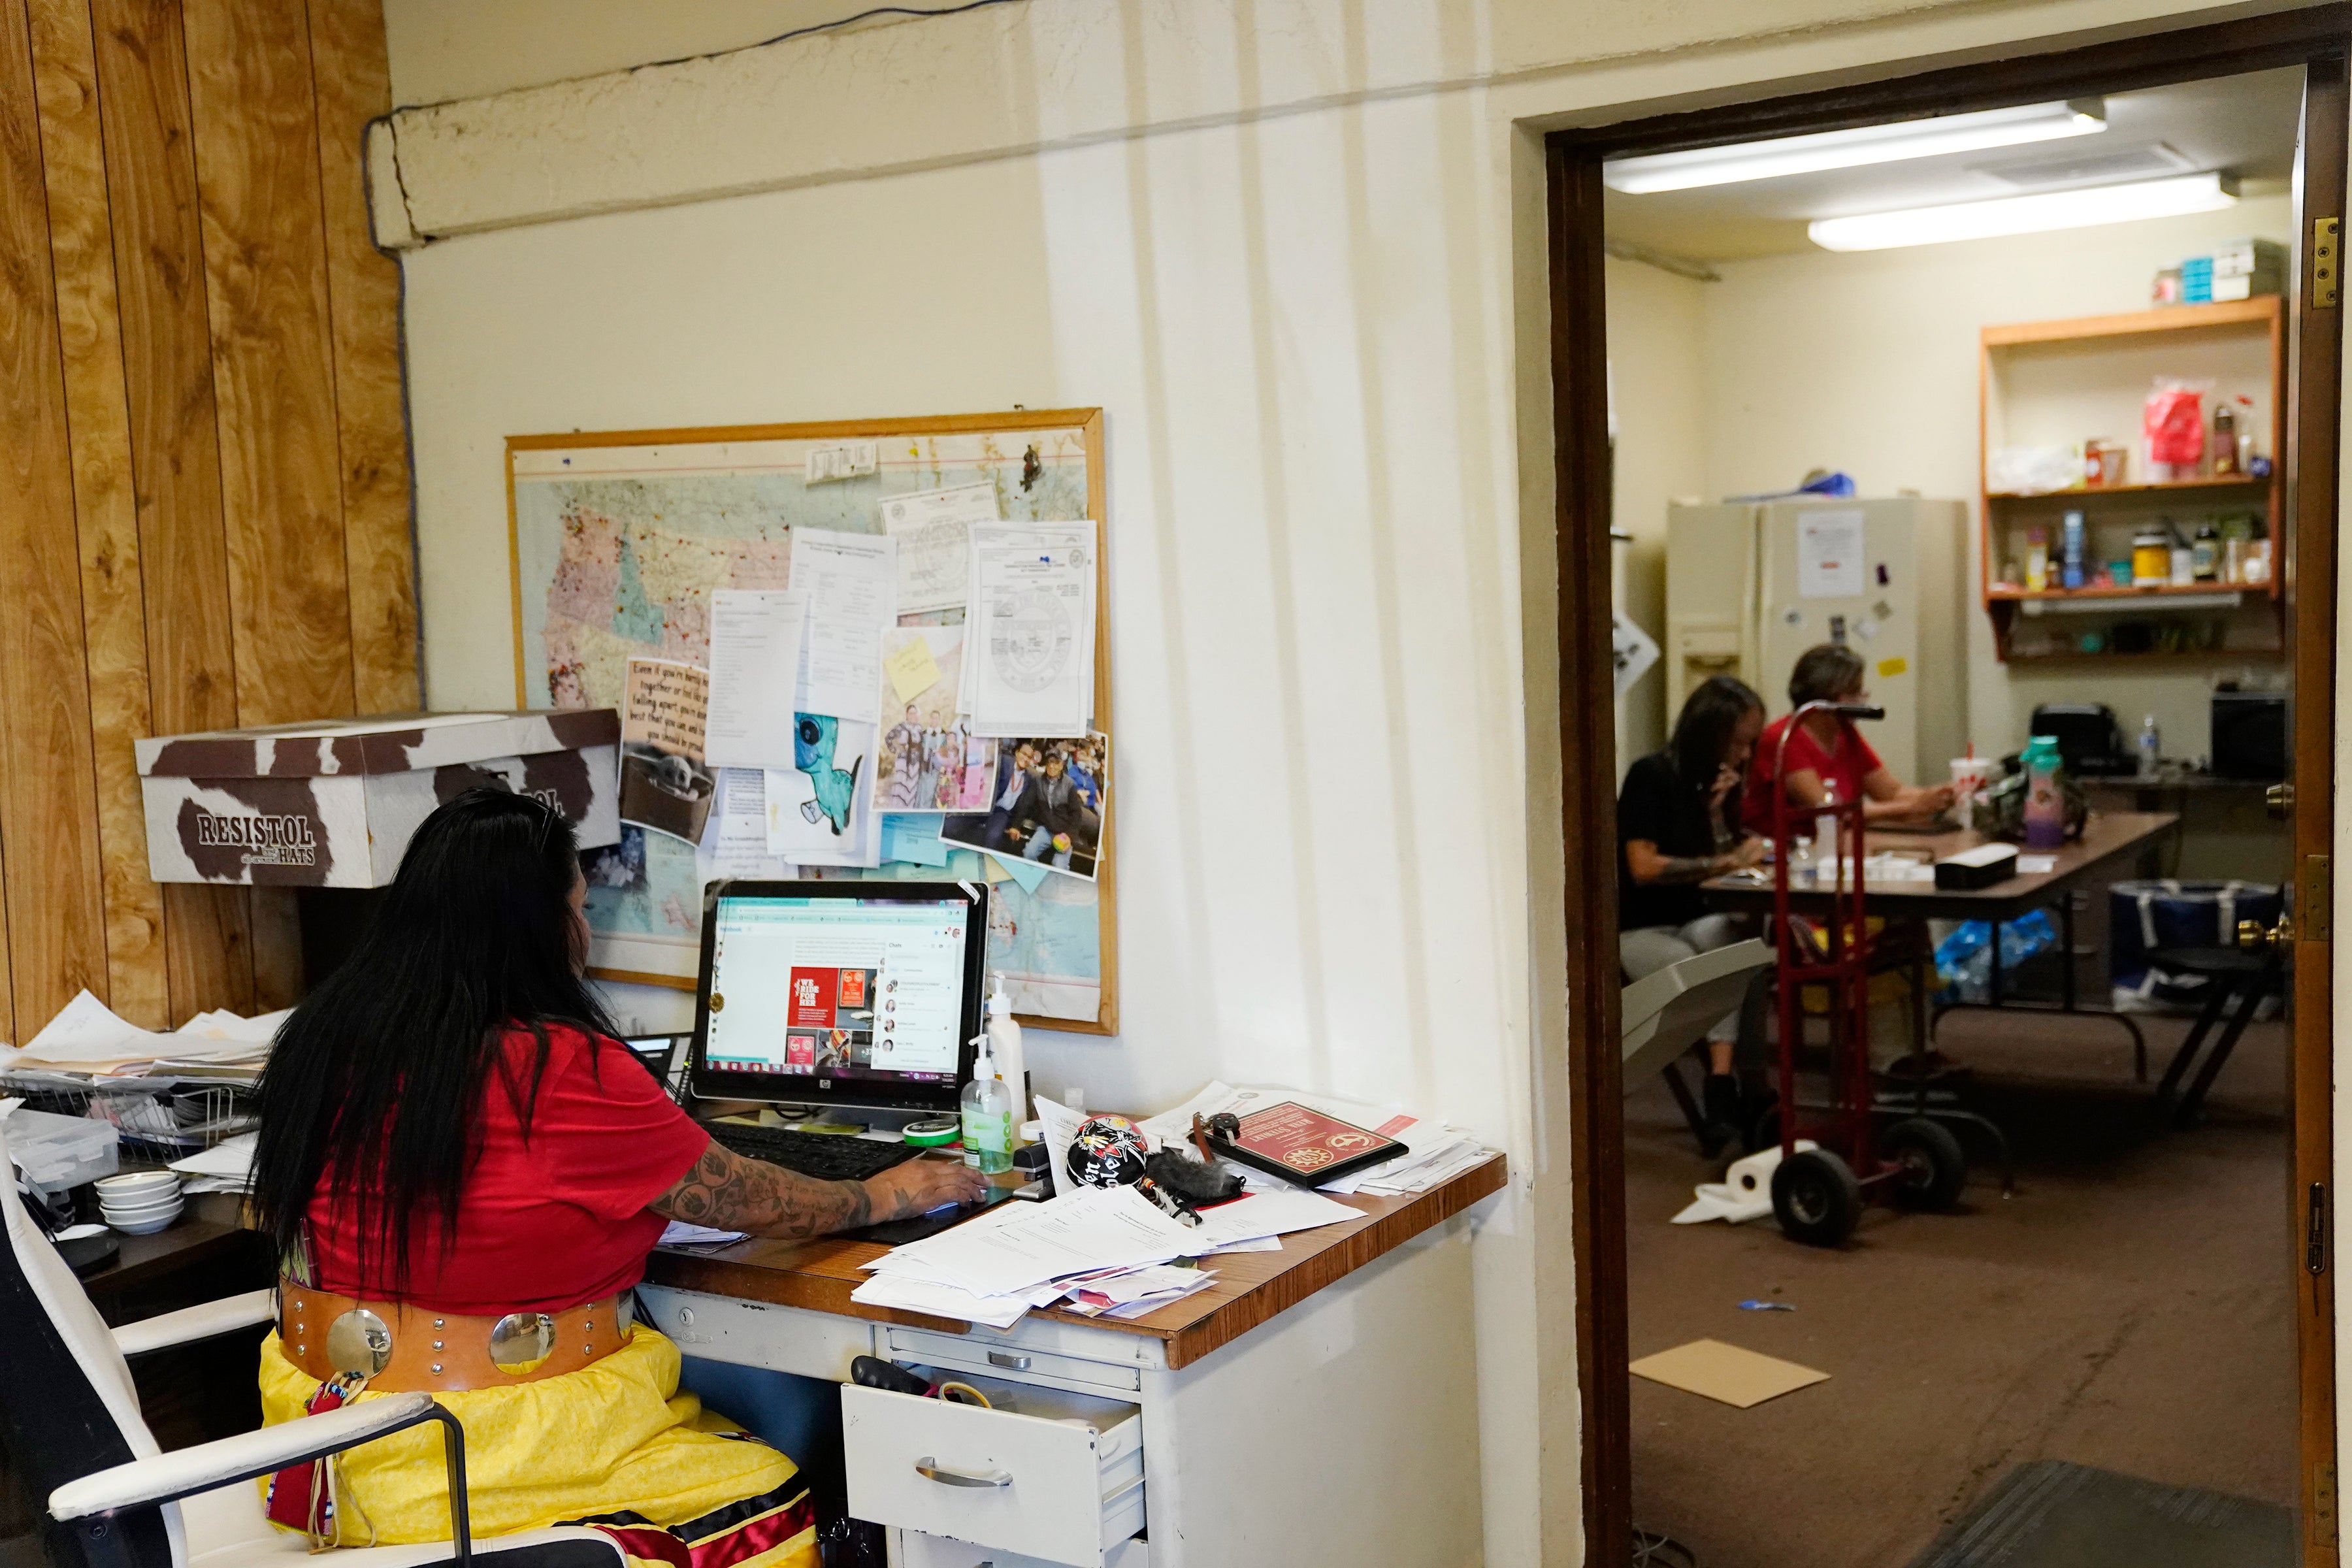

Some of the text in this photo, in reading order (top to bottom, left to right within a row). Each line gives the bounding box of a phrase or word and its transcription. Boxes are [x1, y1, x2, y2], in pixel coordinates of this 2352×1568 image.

[197, 814, 316, 847] RESISTOL
[278, 848, 316, 866] HATS
[800, 979, 815, 987] WE
[800, 985, 819, 994] RIDE
[1287, 1118, 1315, 1128] REVA
